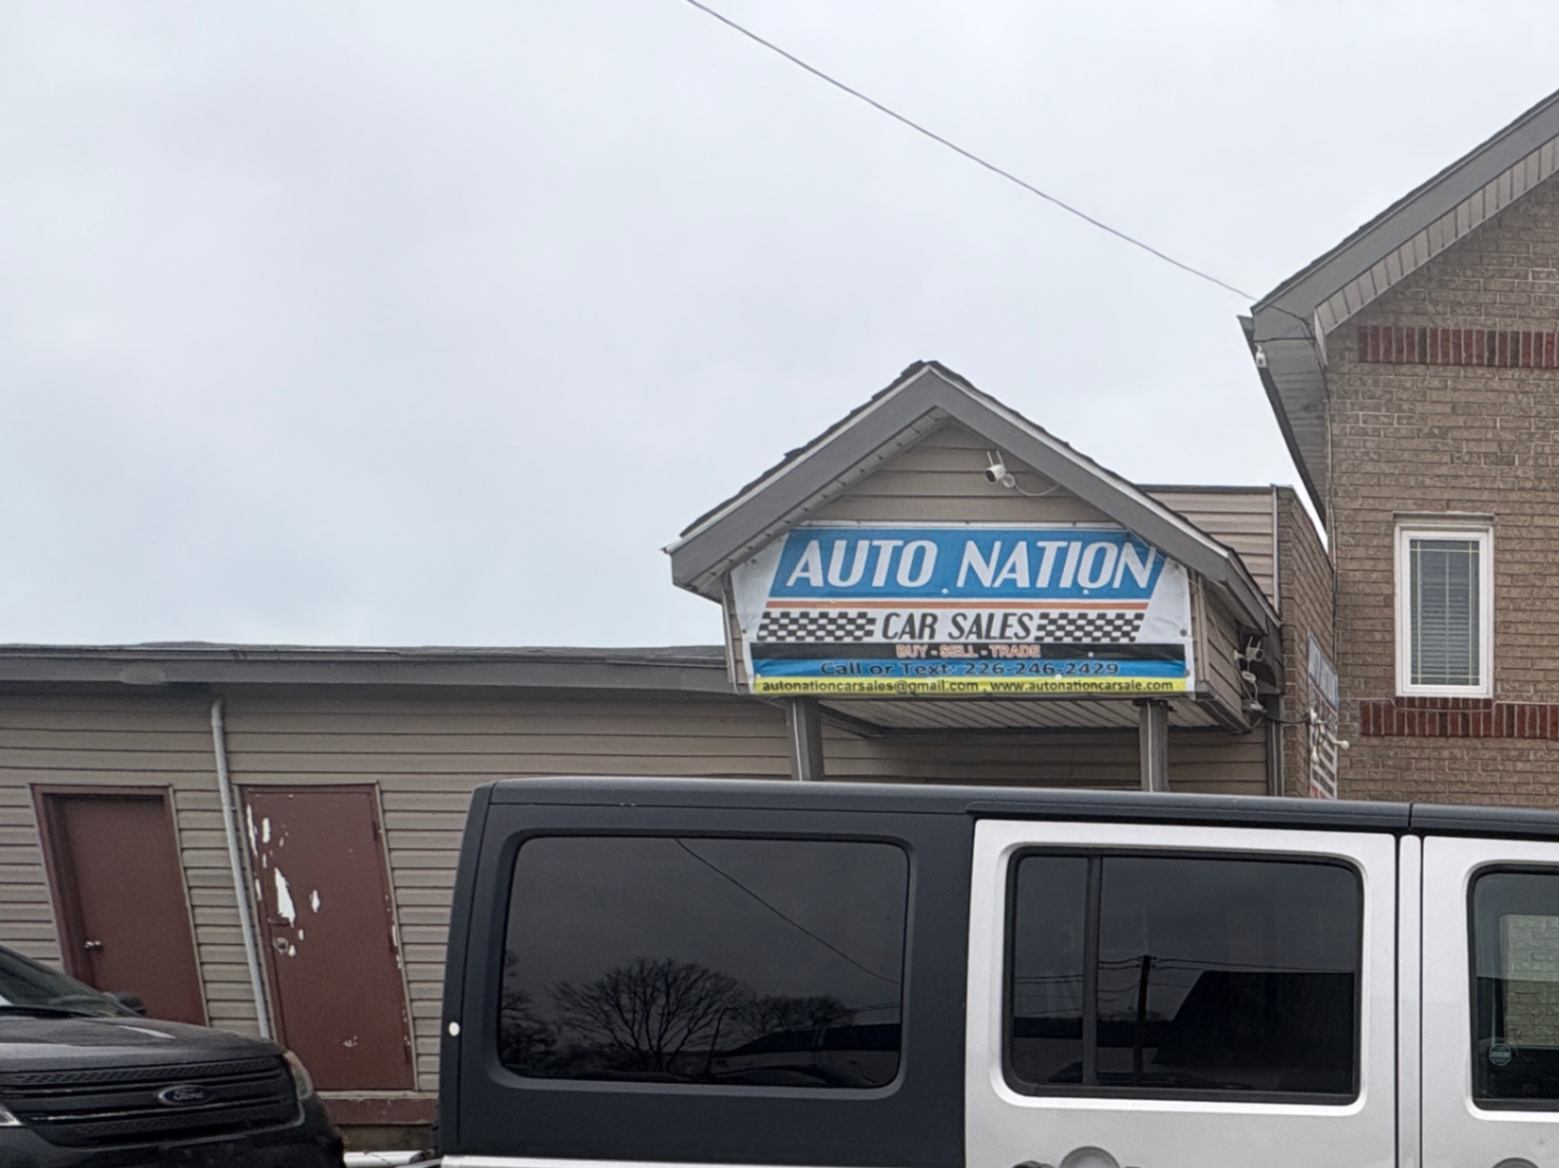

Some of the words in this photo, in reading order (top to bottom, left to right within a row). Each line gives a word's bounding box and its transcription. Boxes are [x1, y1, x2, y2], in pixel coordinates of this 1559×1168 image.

[786, 540, 938, 588] AUTO
[957, 540, 1157, 589] NATION
[881, 612, 938, 640] CAR
[948, 612, 1034, 640] SALES
[896, 644, 928, 659] BUY
[939, 644, 979, 659] SELL
[989, 644, 1041, 659] TRADE
[820, 661, 861, 675] Call
[869, 665, 895, 675] or
[901, 661, 956, 675] Text:
[964, 661, 1120, 675] 226-246-2429
[762, 679, 979, 695] autonationcarsales@gmail.com
[990, 679, 1173, 692] www.autonationcarsale.com
